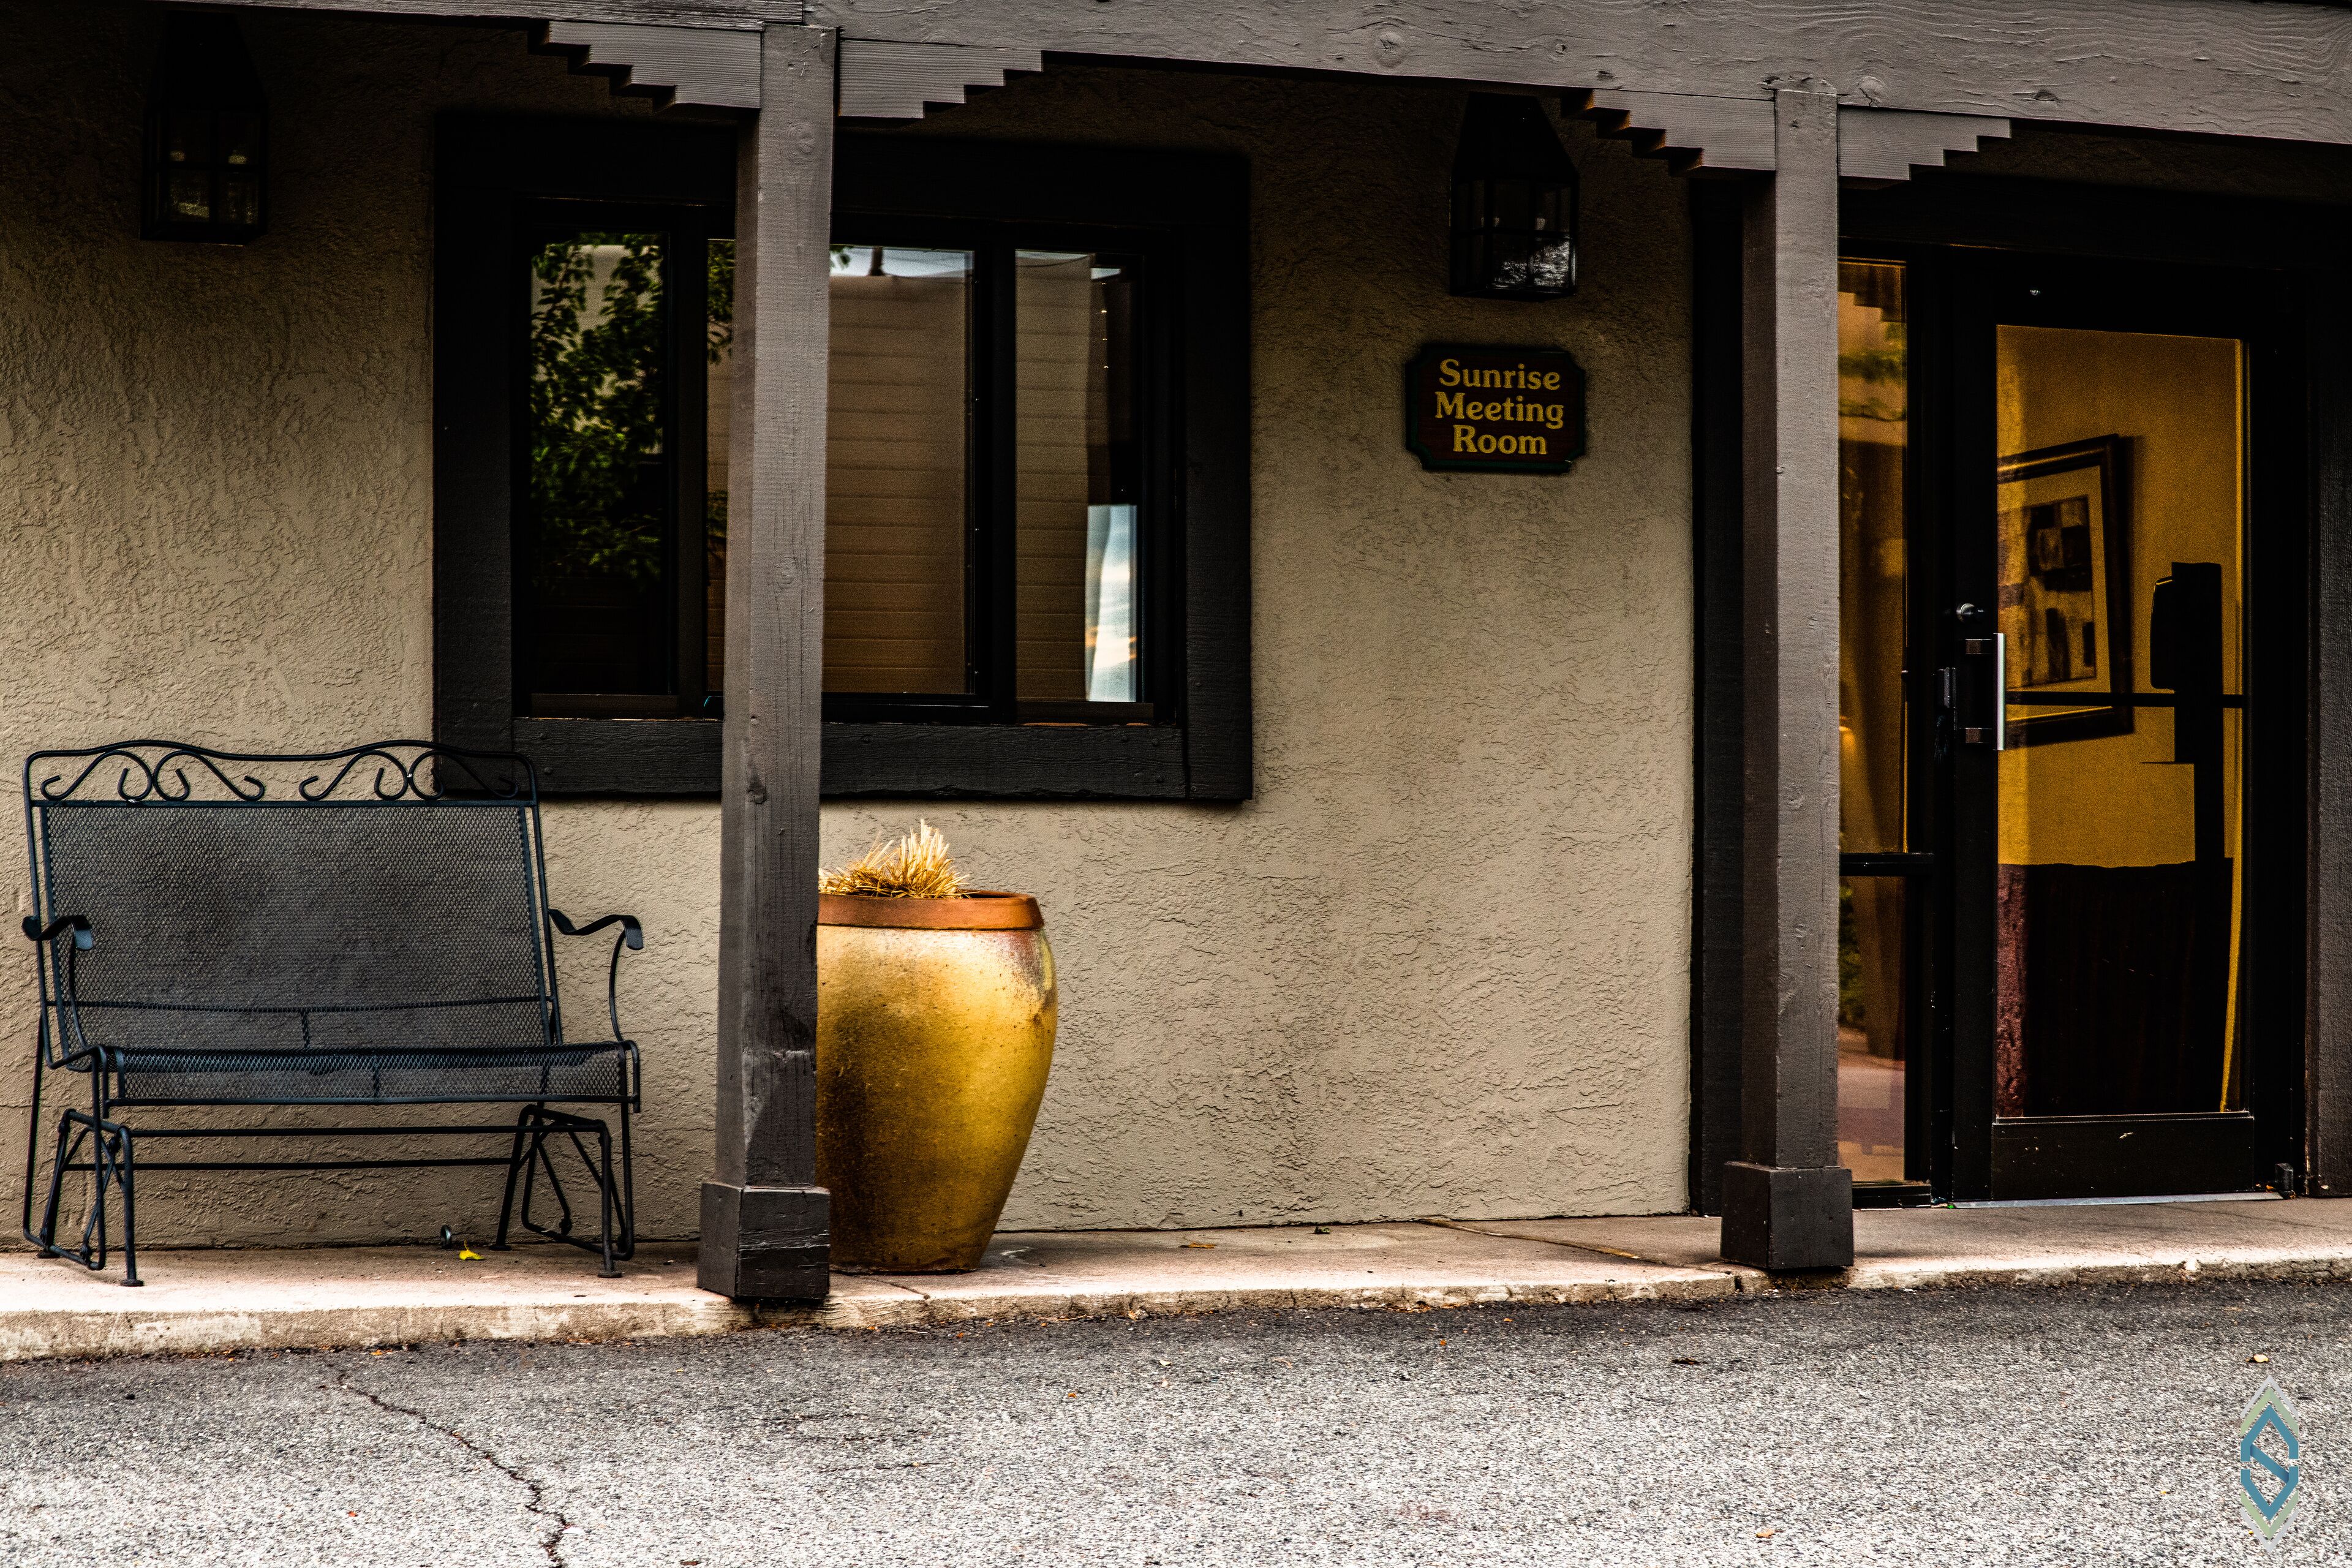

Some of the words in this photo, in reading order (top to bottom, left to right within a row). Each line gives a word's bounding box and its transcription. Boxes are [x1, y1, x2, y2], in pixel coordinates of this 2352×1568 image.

[1439, 358, 1560, 391] Sunrise
[1434, 391, 1564, 429] Meeting
[1452, 424, 1547, 455] Room
